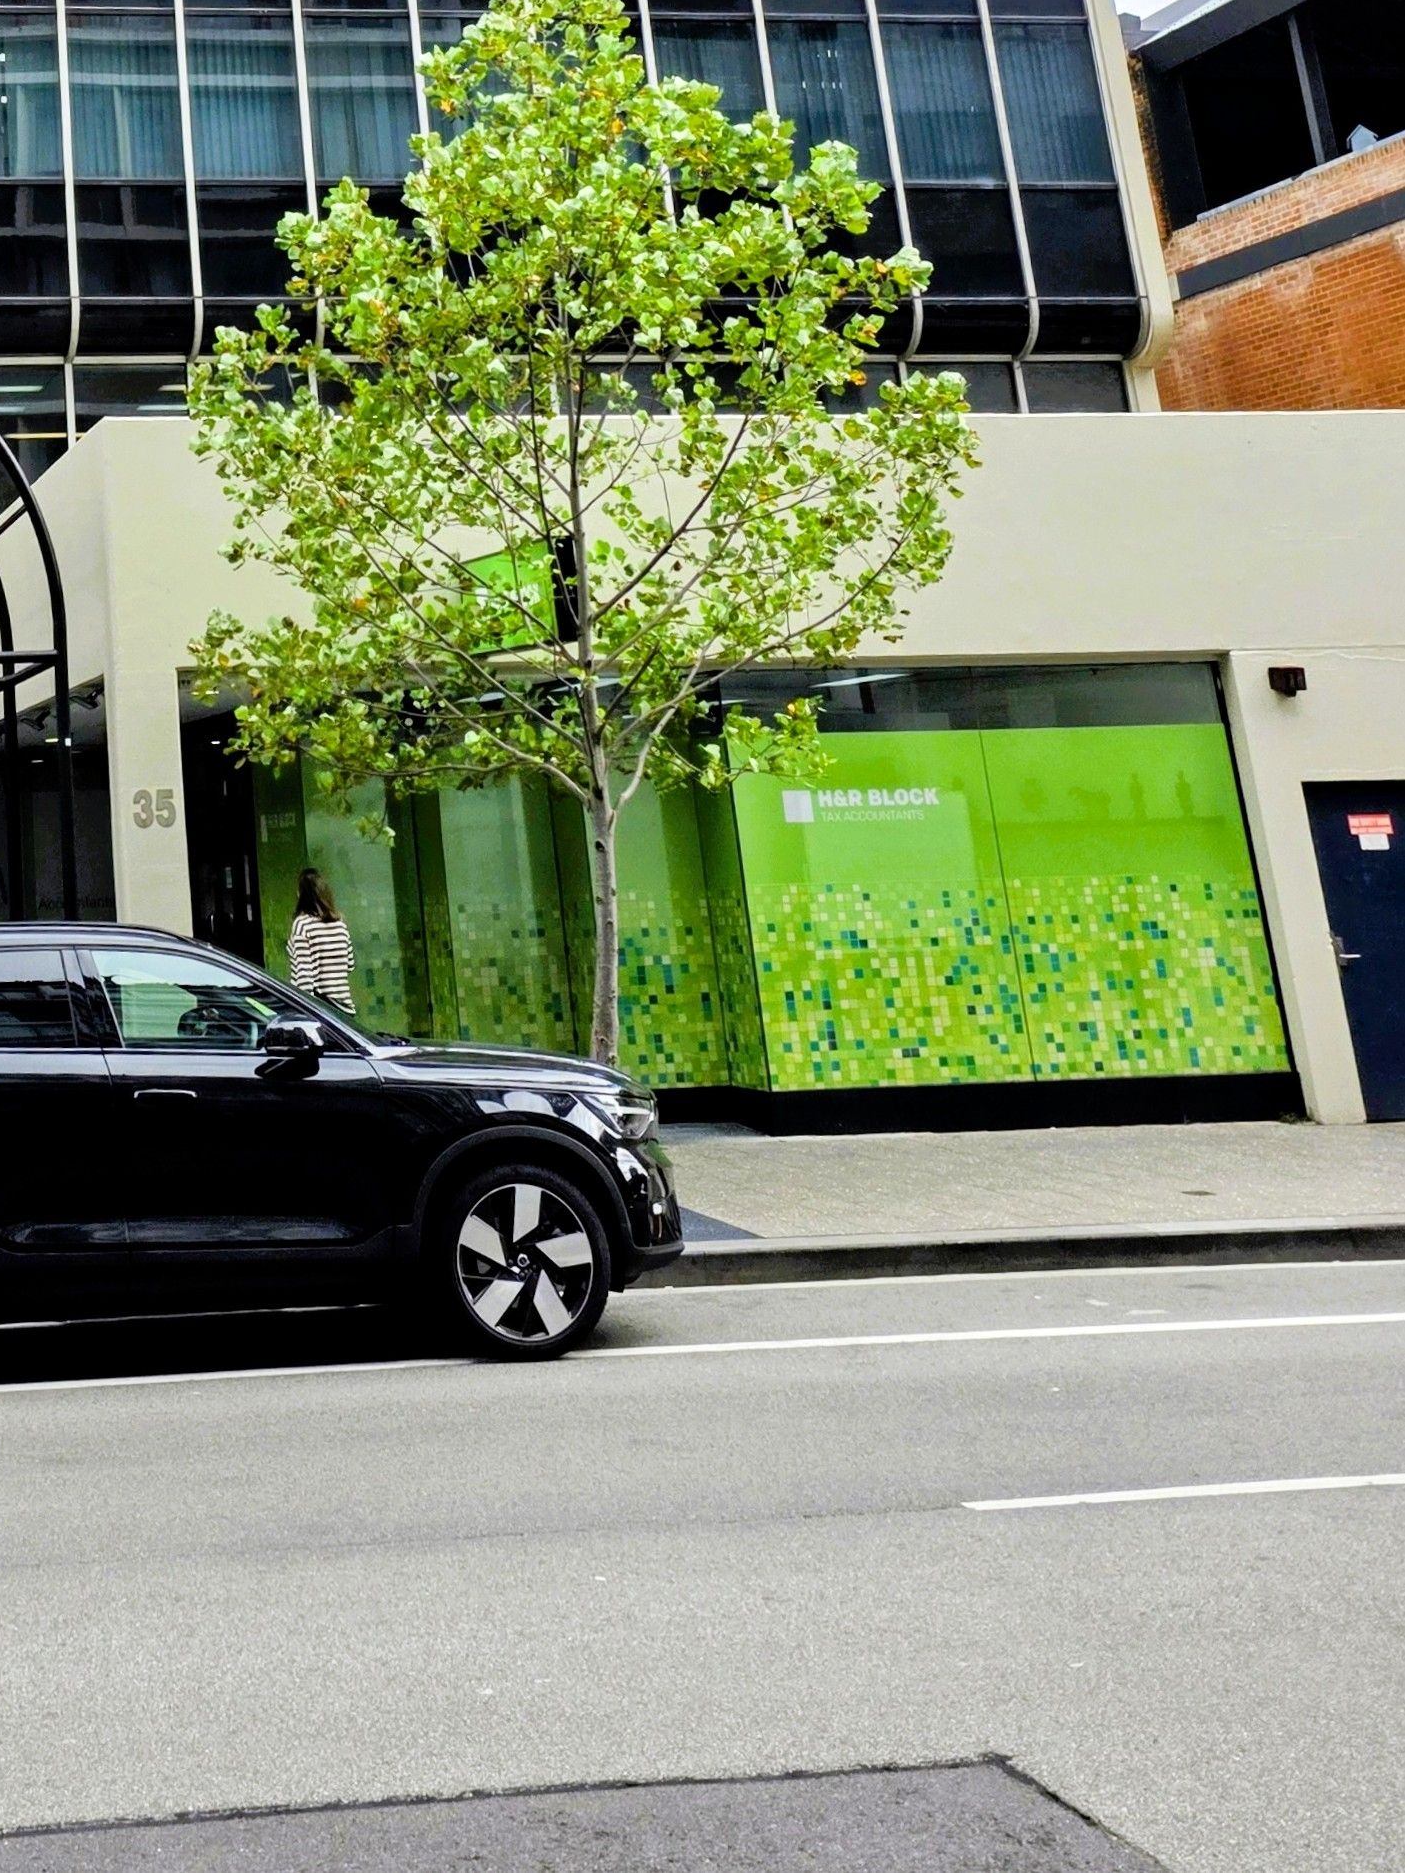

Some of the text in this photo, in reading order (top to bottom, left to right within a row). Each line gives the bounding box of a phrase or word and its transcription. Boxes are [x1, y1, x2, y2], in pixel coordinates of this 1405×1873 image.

[816, 787, 940, 807] H&R BLOCK
[132, 788, 177, 829] 35
[821, 809, 925, 823] TAX ACCOUNTANTS
